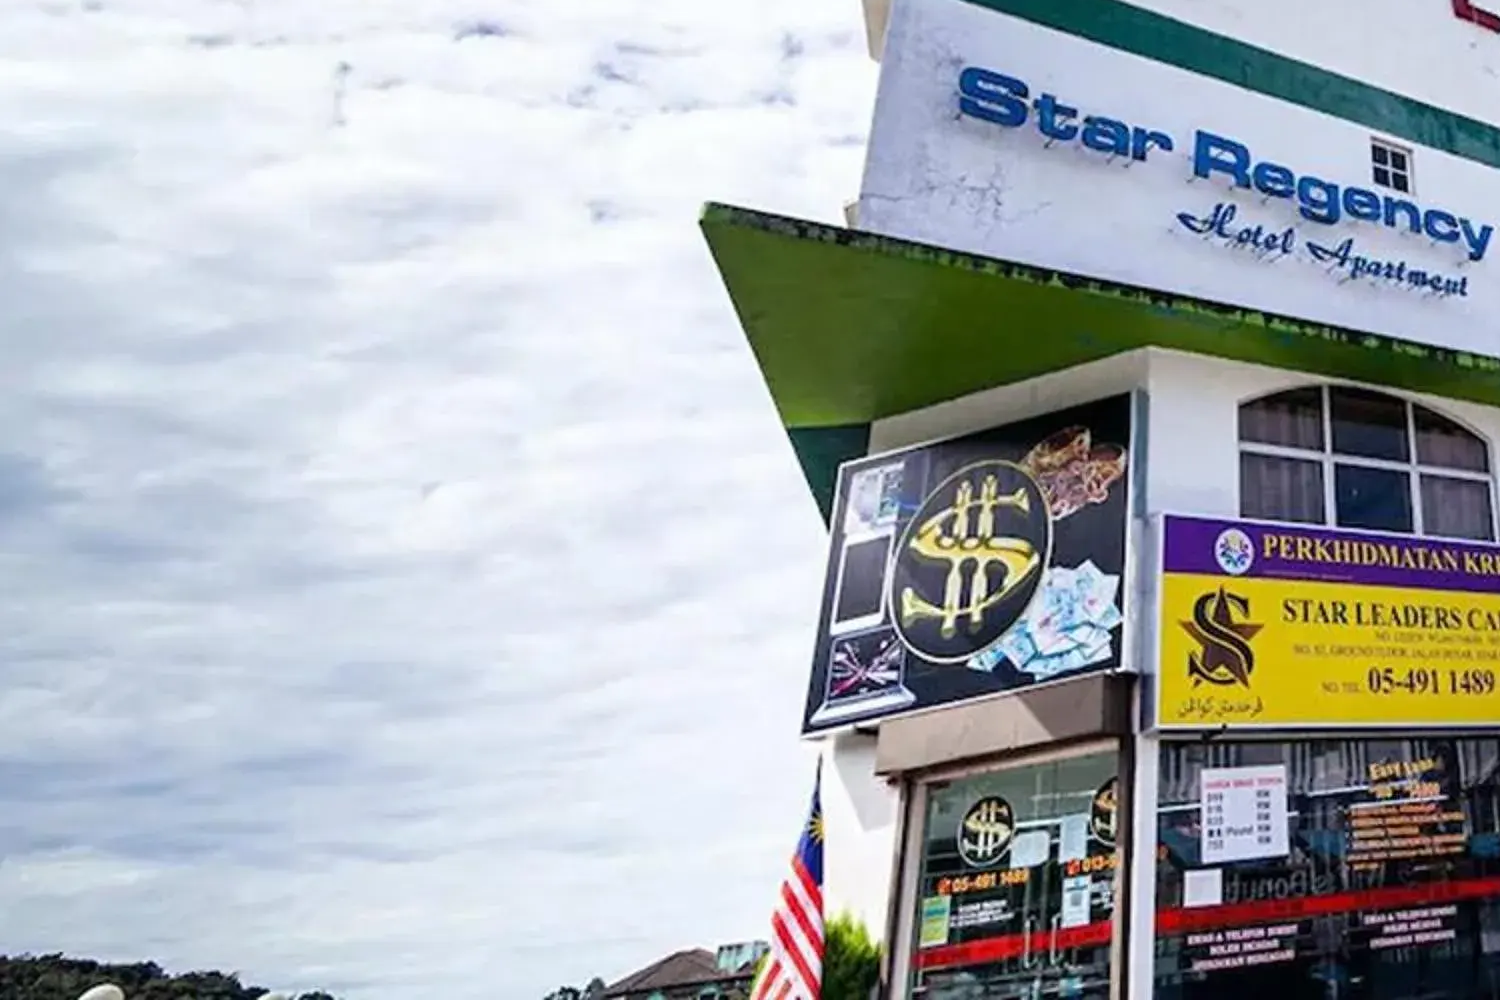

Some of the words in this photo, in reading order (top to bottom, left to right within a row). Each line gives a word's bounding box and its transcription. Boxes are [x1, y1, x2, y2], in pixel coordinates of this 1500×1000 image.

[958, 66, 1174, 162] Star
[1193, 128, 1494, 261] Regency
[1176, 202, 1294, 255] Hotel
[1306, 238, 1469, 298] Apartment
[1263, 533, 1460, 573] PERKHIDMATAN
[1283, 598, 1349, 625] STAR
[1354, 601, 1463, 630] LEADERS
[1368, 666, 1439, 695] 05-491
[1449, 668, 1495, 696] 1489
